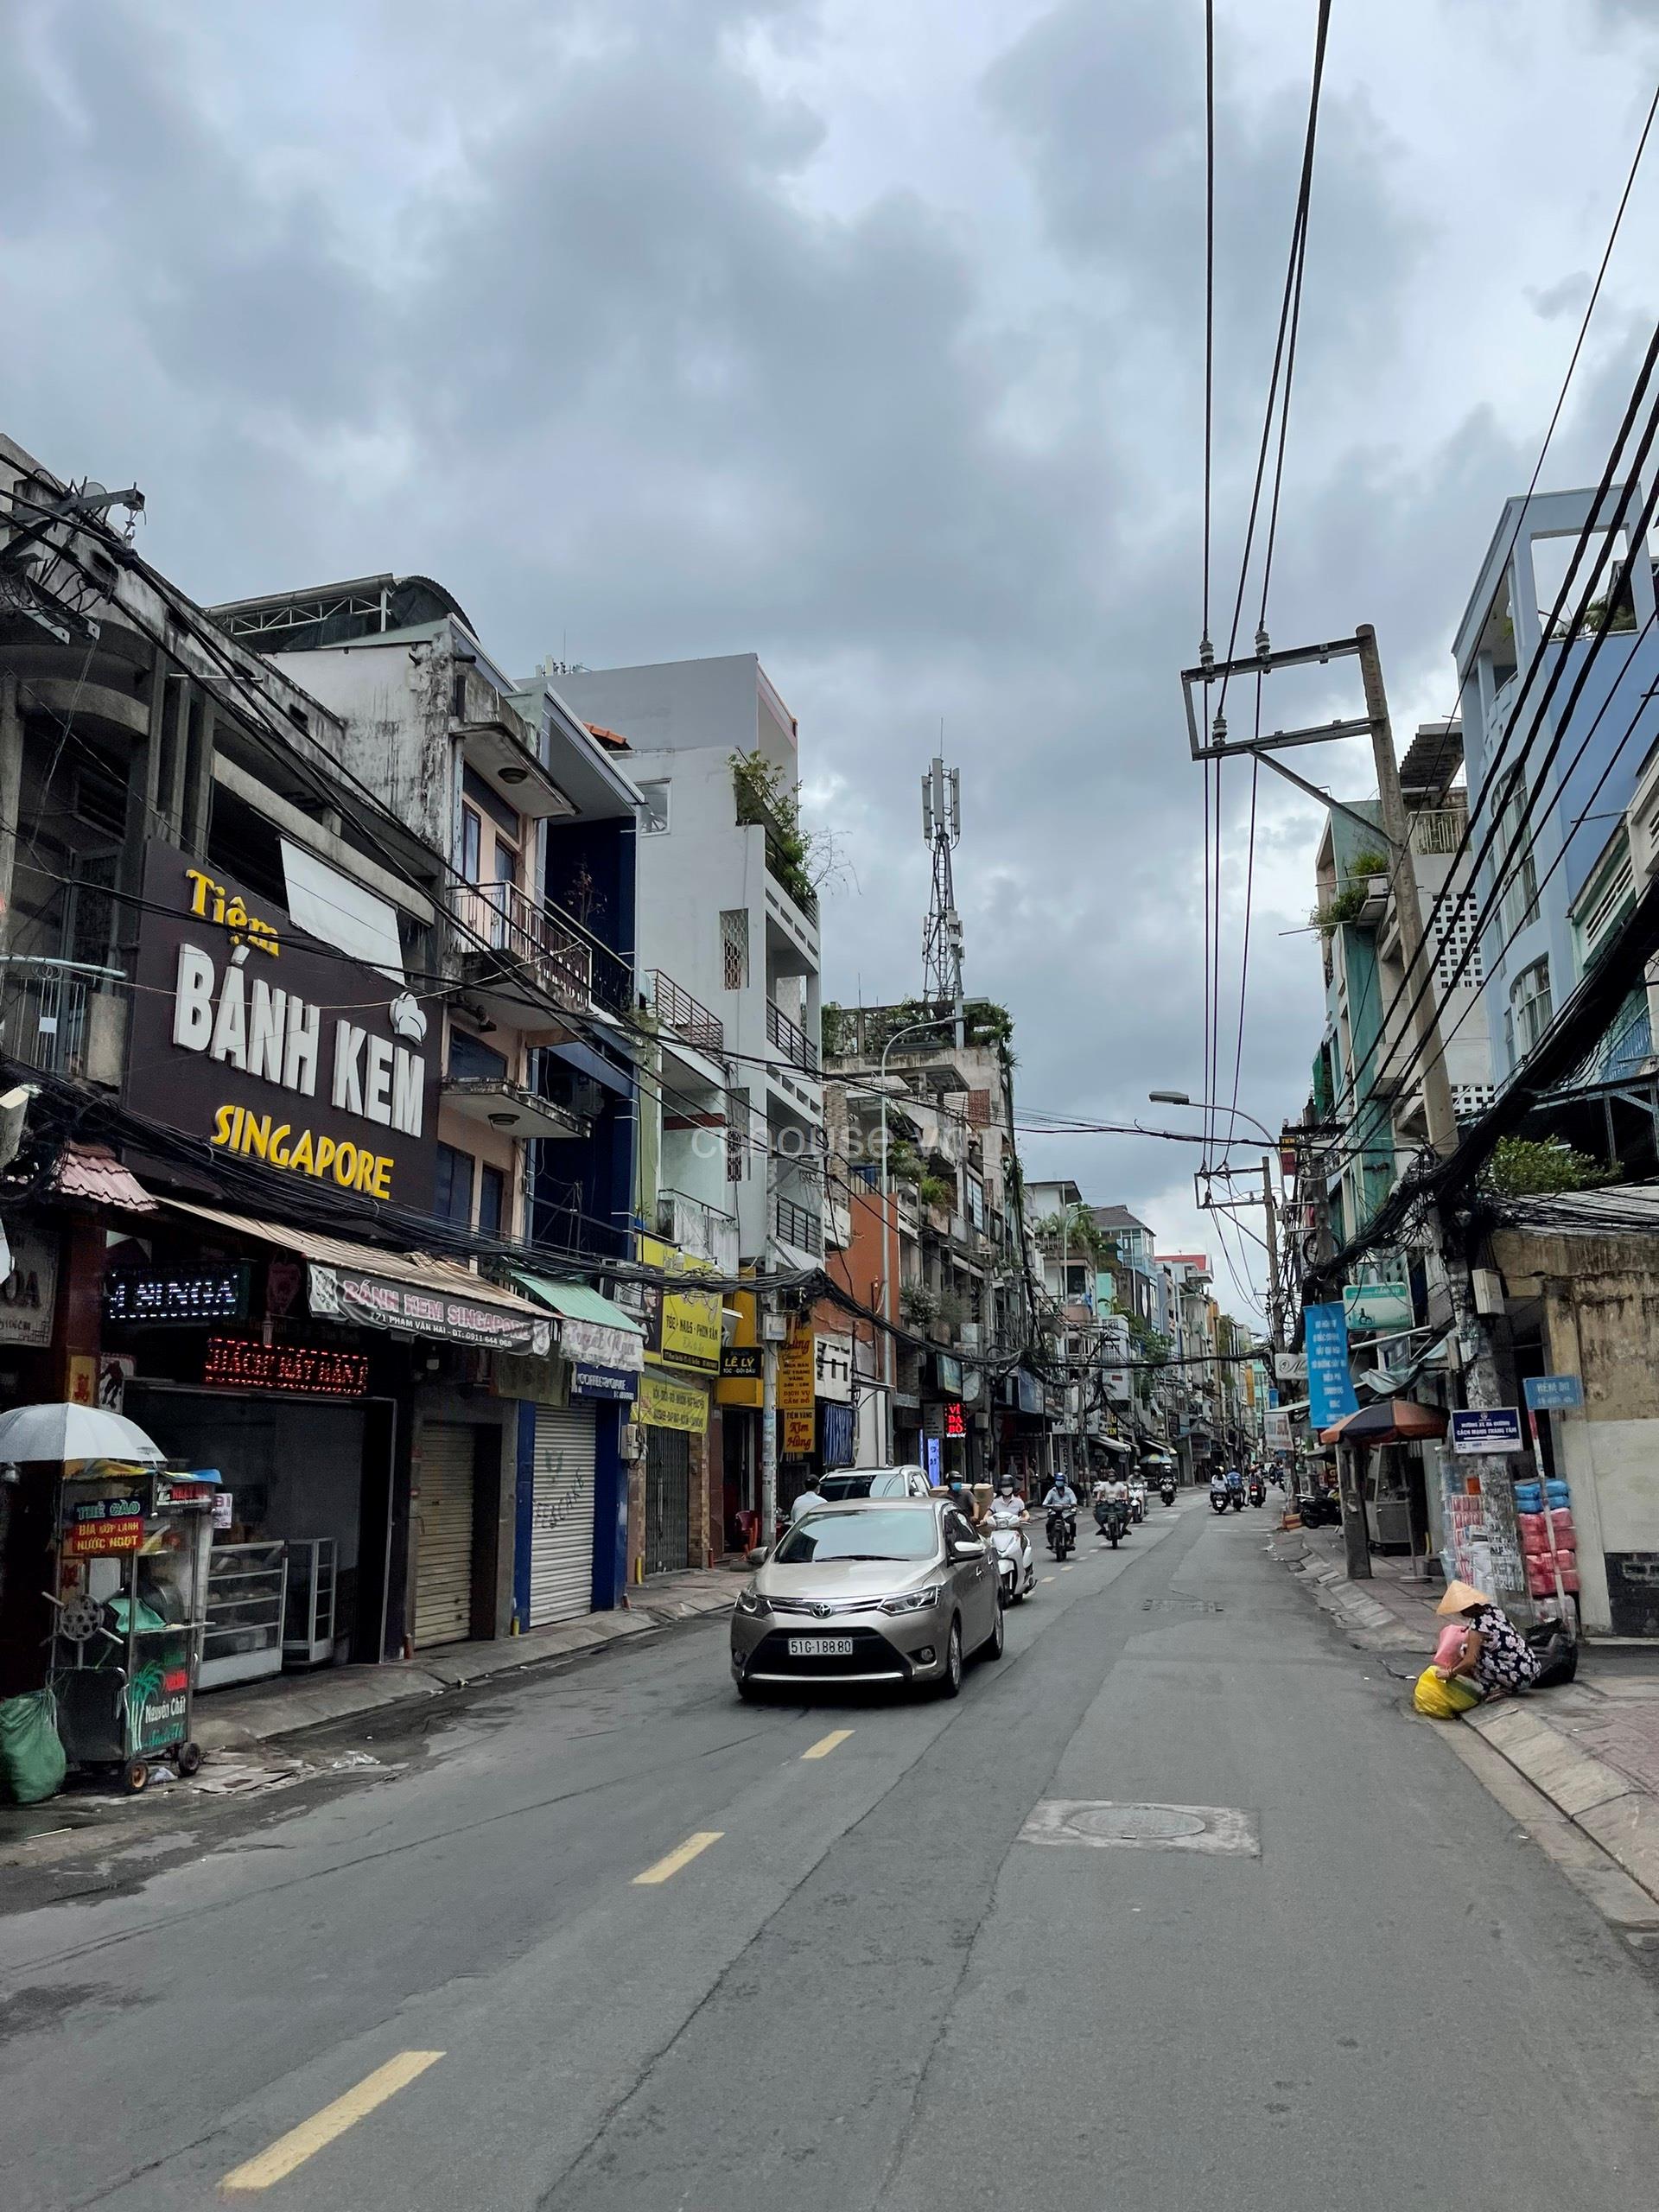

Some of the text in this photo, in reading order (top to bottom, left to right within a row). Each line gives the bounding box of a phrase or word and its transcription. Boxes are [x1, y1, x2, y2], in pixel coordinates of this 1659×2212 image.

[186, 869, 280, 958] Tiệm
[173, 943, 425, 1139] BÁNH KEM
[211, 1105, 394, 1200] SINGAPORE
[343, 1279, 534, 1339] BÁNH KEM SINGAPORE
[370, 1312, 387, 1323] 171
[724, 1355, 739, 1368] LÊ
[741, 1355, 756, 1369] LÝ
[948, 1415, 963, 1424] DA
[109, 1499, 141, 1516] CÀO
